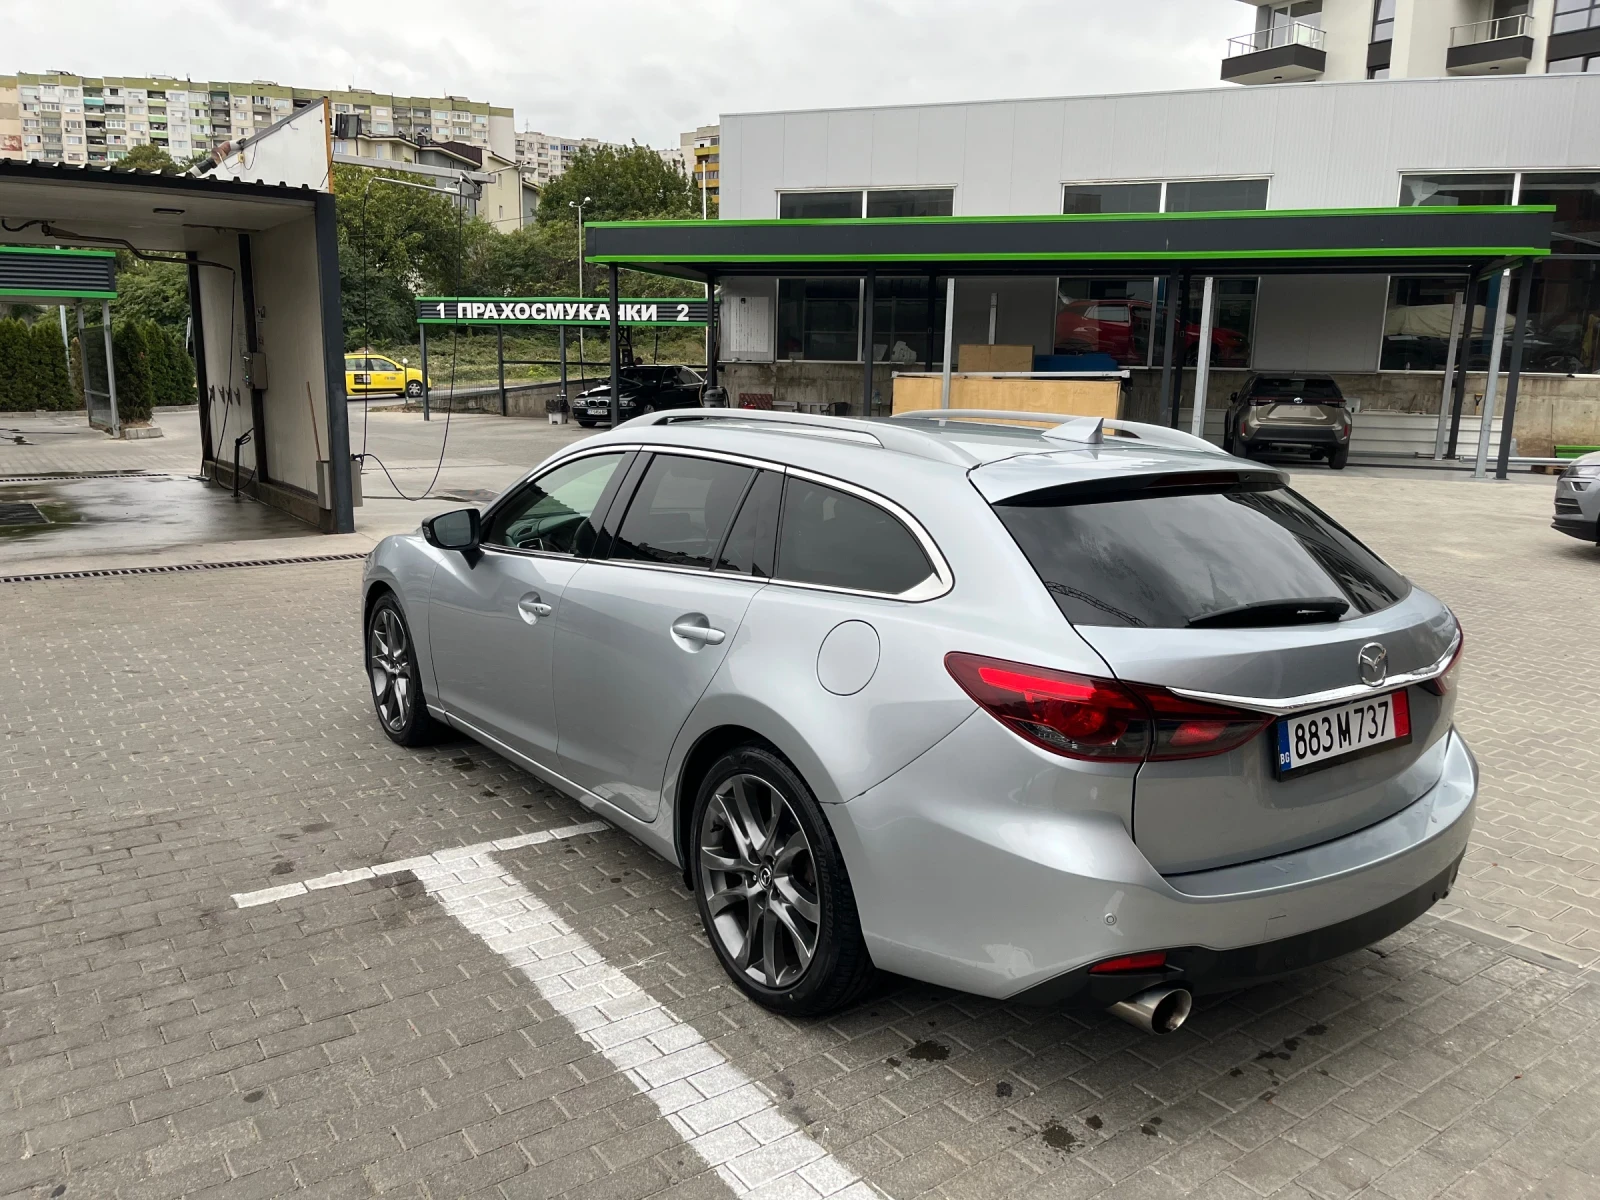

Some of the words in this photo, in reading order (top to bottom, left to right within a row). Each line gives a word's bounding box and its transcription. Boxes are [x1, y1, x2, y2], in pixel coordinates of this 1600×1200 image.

[436, 302, 446, 319] 1
[676, 304, 690, 321] 2
[1280, 751, 1290, 765] BG
